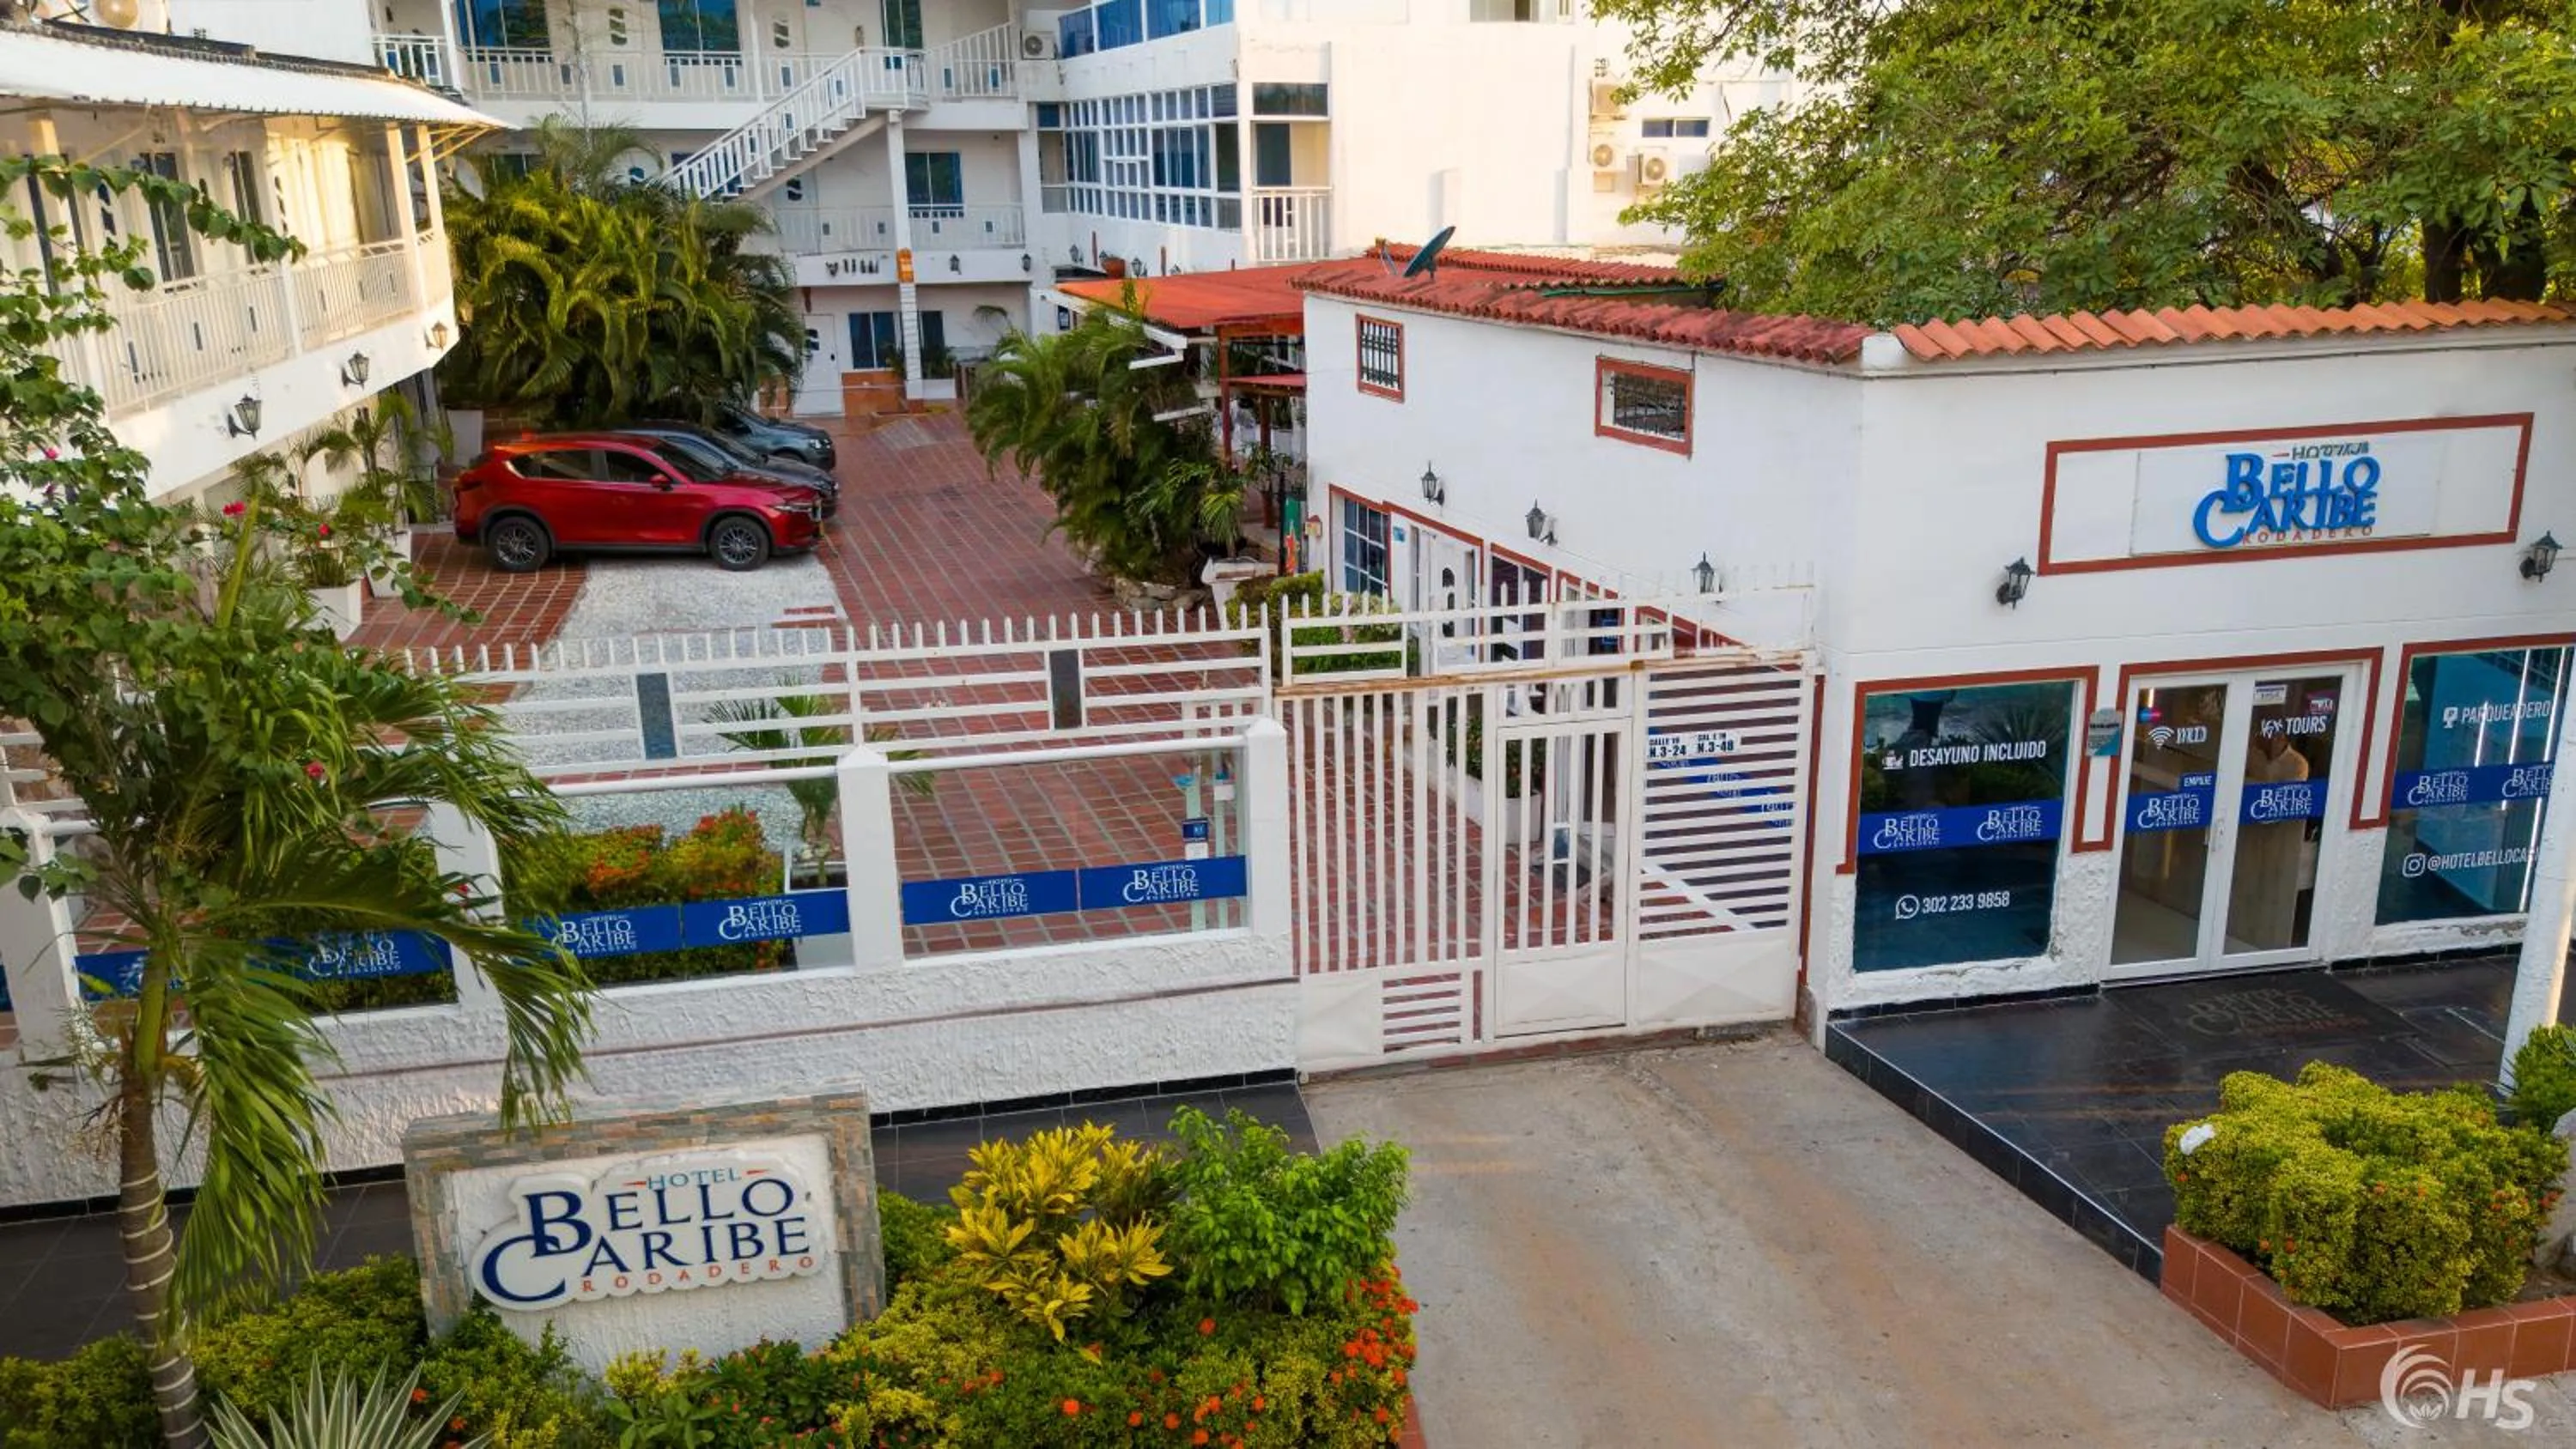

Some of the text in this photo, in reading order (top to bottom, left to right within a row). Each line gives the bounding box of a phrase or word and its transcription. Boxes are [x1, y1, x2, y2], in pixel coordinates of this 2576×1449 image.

[2221, 453, 2381, 513] BELLO
[2193, 488, 2378, 549] CARIBE
[2242, 525, 2372, 544] RODADERO
[2286, 715, 2328, 734] TOURS
[1910, 740, 2047, 767] DESAYUNO INCLUIDO
[2408, 785, 2467, 804] CARIBE
[2418, 774, 2469, 793] BELLO
[2148, 797, 2199, 817] BELLO
[2261, 788, 2312, 807] BELLO
[1885, 817, 1938, 837] BELLO
[1988, 809, 2041, 829] BELLO
[2137, 807, 2201, 828] CARIBE
[1874, 827, 1941, 849] CARIBE
[1978, 819, 2044, 841] CARIBE
[1133, 868, 1196, 890] BELLO
[961, 882, 1024, 905] BELLO
[1122, 879, 1199, 903] CARIBE
[1922, 890, 2010, 914] 302 233 9858
[727, 904, 798, 927] BELLO
[951, 894, 1027, 918] CARIBE
[562, 919, 632, 943] BELLO
[719, 914, 801, 940] CARIBE
[647, 1167, 741, 1191] HOTEL
[522, 1178, 794, 1258] BELLO
[481, 1216, 810, 1303] CARIBE
[580, 1256, 814, 1293] RODADERO
